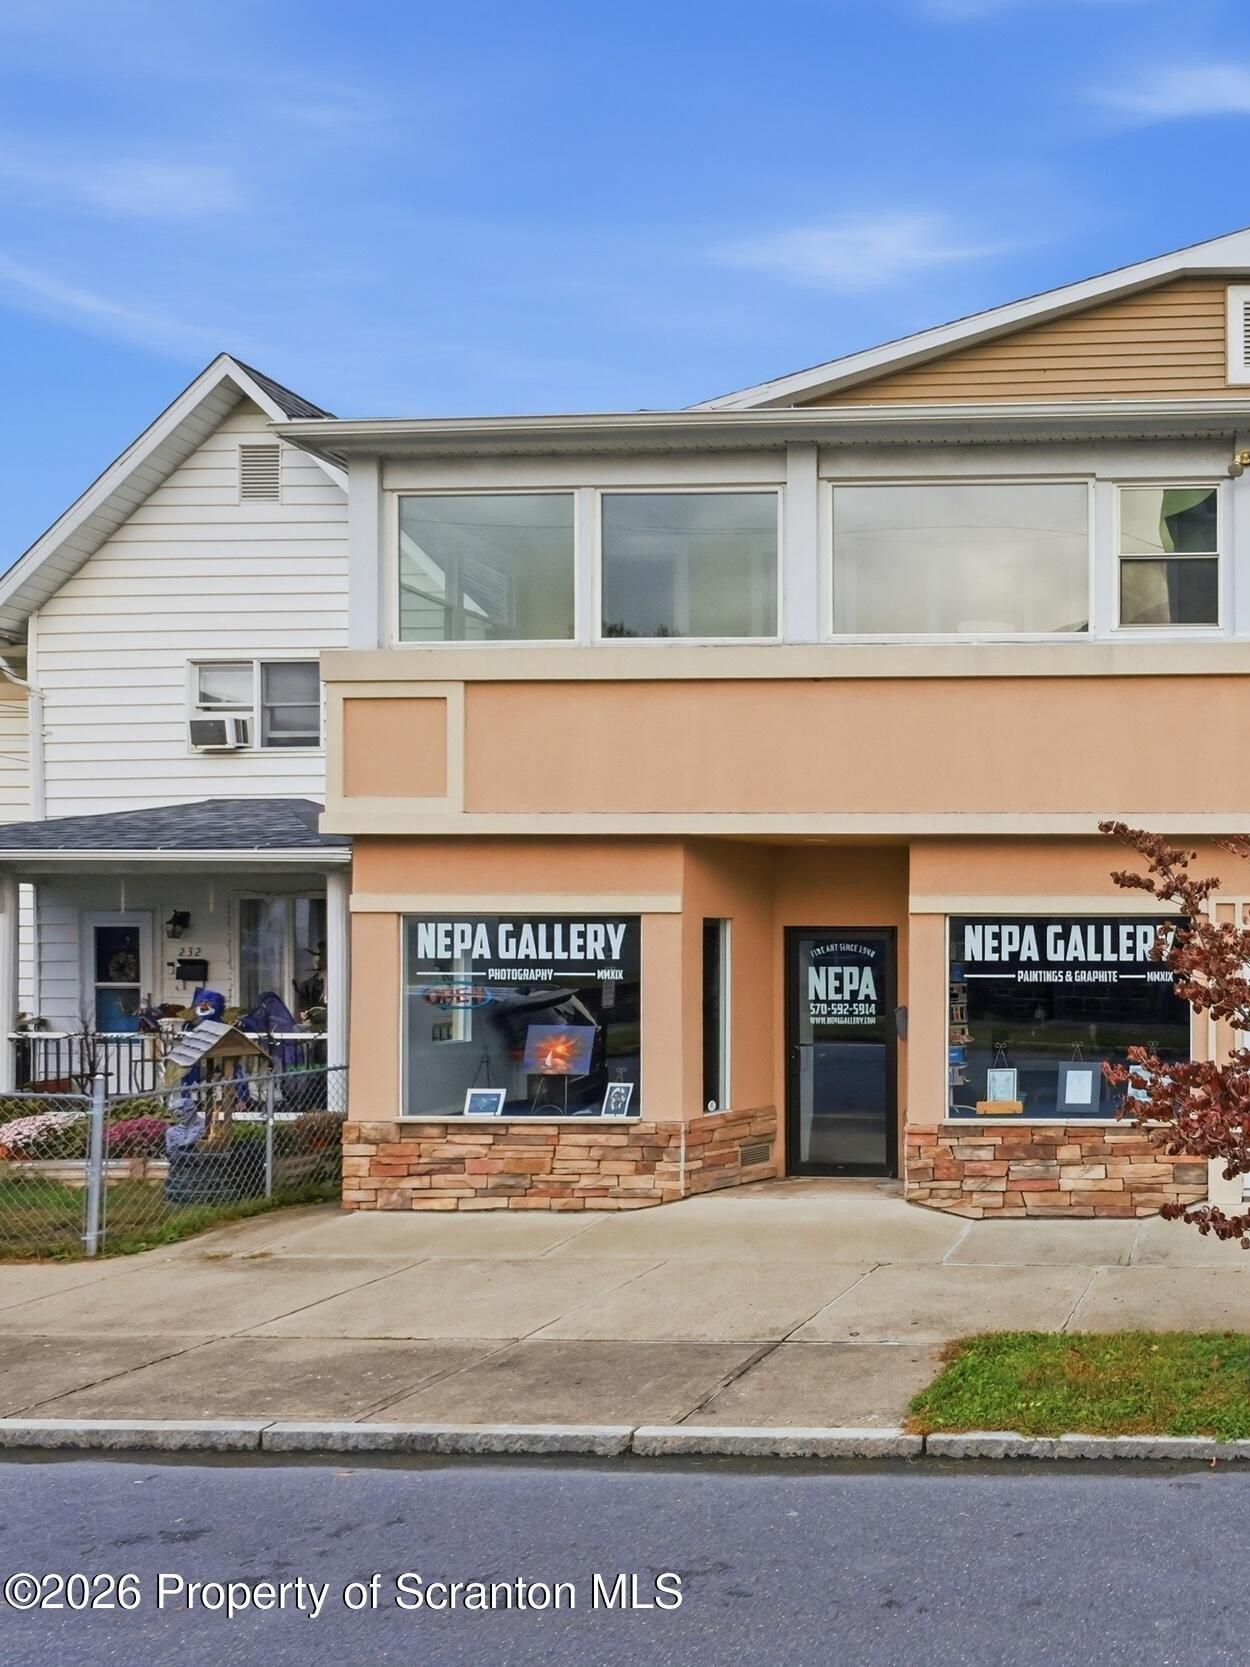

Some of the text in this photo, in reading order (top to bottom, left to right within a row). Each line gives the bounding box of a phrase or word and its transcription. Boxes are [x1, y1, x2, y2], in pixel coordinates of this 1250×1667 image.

[417, 922, 626, 960] NEPA GALLERY
[964, 924, 1040, 962] NEPA
[178, 947, 201, 956] 232
[488, 968, 623, 981] PHOTOGRAPHY MMXIX
[1017, 970, 1174, 982] PAINTINGS & GRAPHITE MMXIX
[808, 966, 877, 1000] NEPA
[810, 1003, 876, 1015] 570-592-5914
